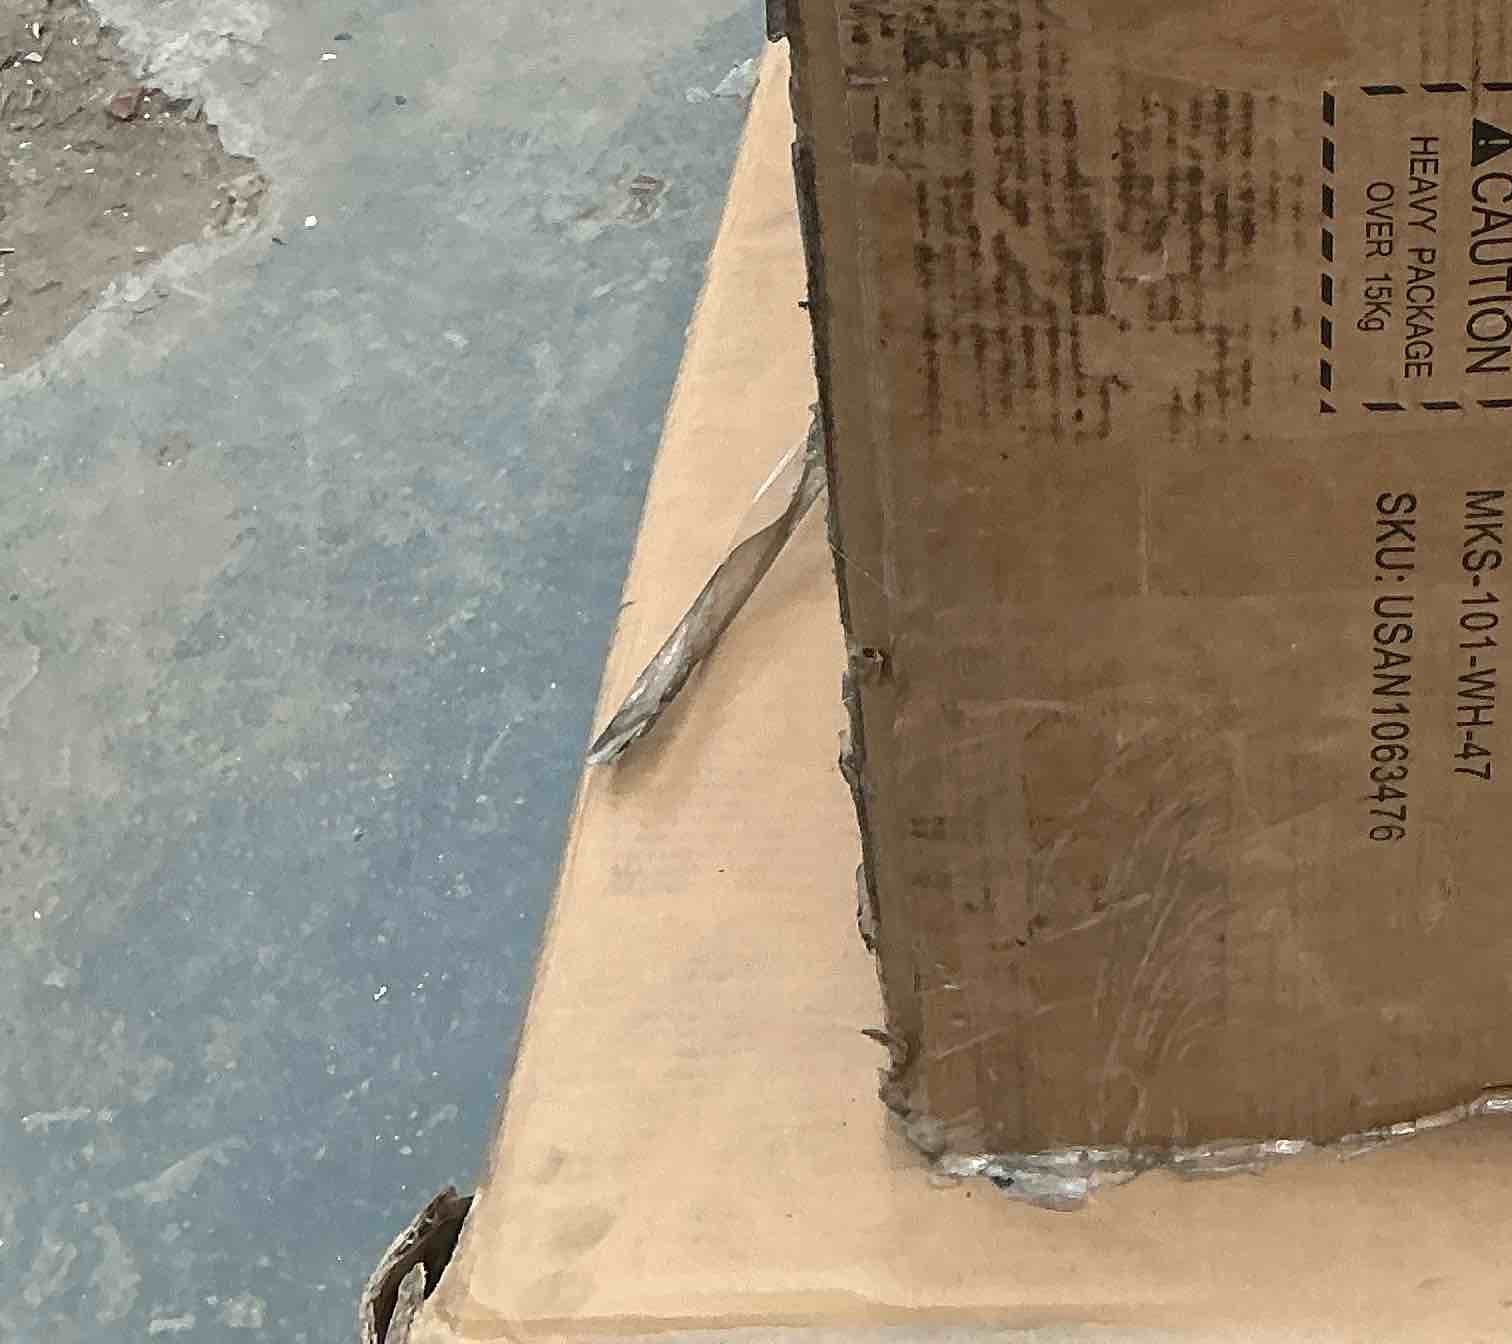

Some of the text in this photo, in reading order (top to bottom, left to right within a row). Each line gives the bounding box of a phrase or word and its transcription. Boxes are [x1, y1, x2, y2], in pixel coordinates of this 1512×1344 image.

[1356, 180, 1396, 332] OVER 15Kg
[1404, 136, 1440, 379] HEAVY PACKAGE
[1368, 491, 1418, 842] SKU: USAN1063476
[1453, 489, 1506, 782] MKS-101-WH-47
